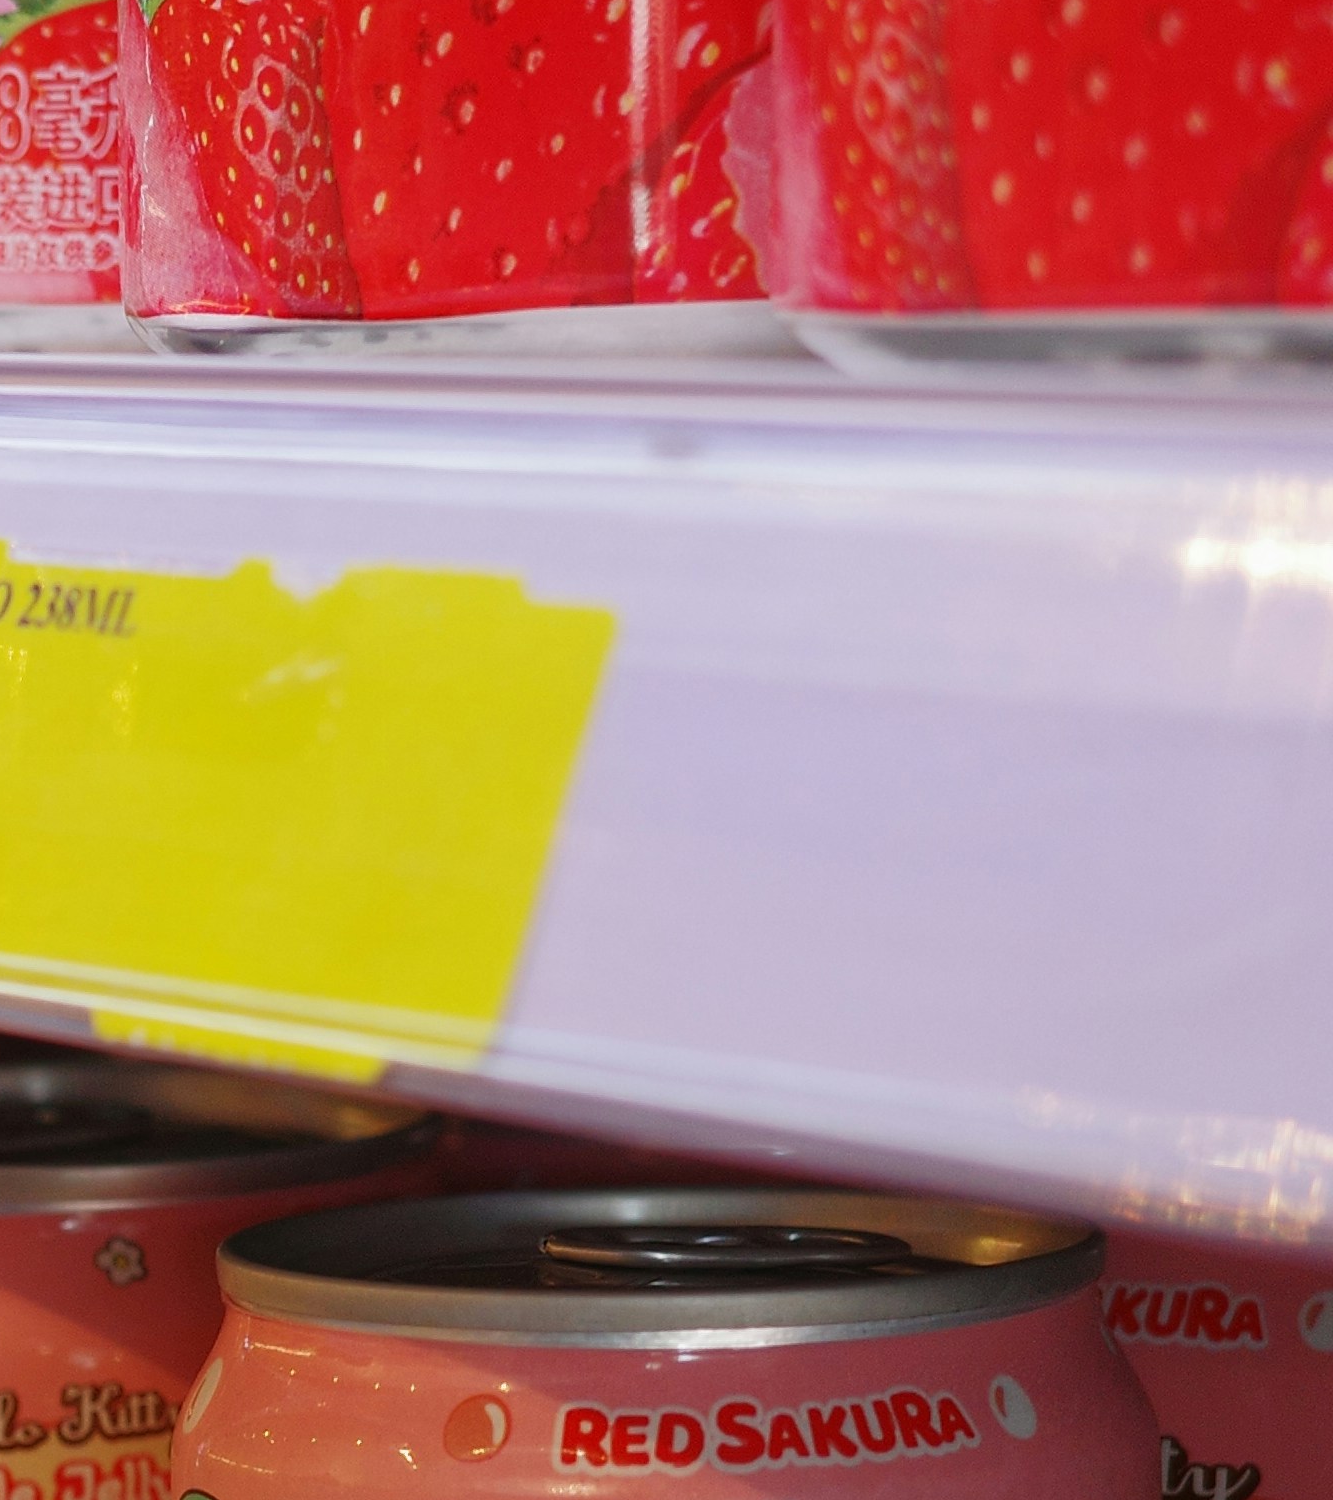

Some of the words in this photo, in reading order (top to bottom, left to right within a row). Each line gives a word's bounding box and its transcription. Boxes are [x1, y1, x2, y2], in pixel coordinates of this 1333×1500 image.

[16, 583, 139, 638] 238ML
[561, 1404, 703, 1470] RED
[717, 1390, 975, 1466] SAKURA
